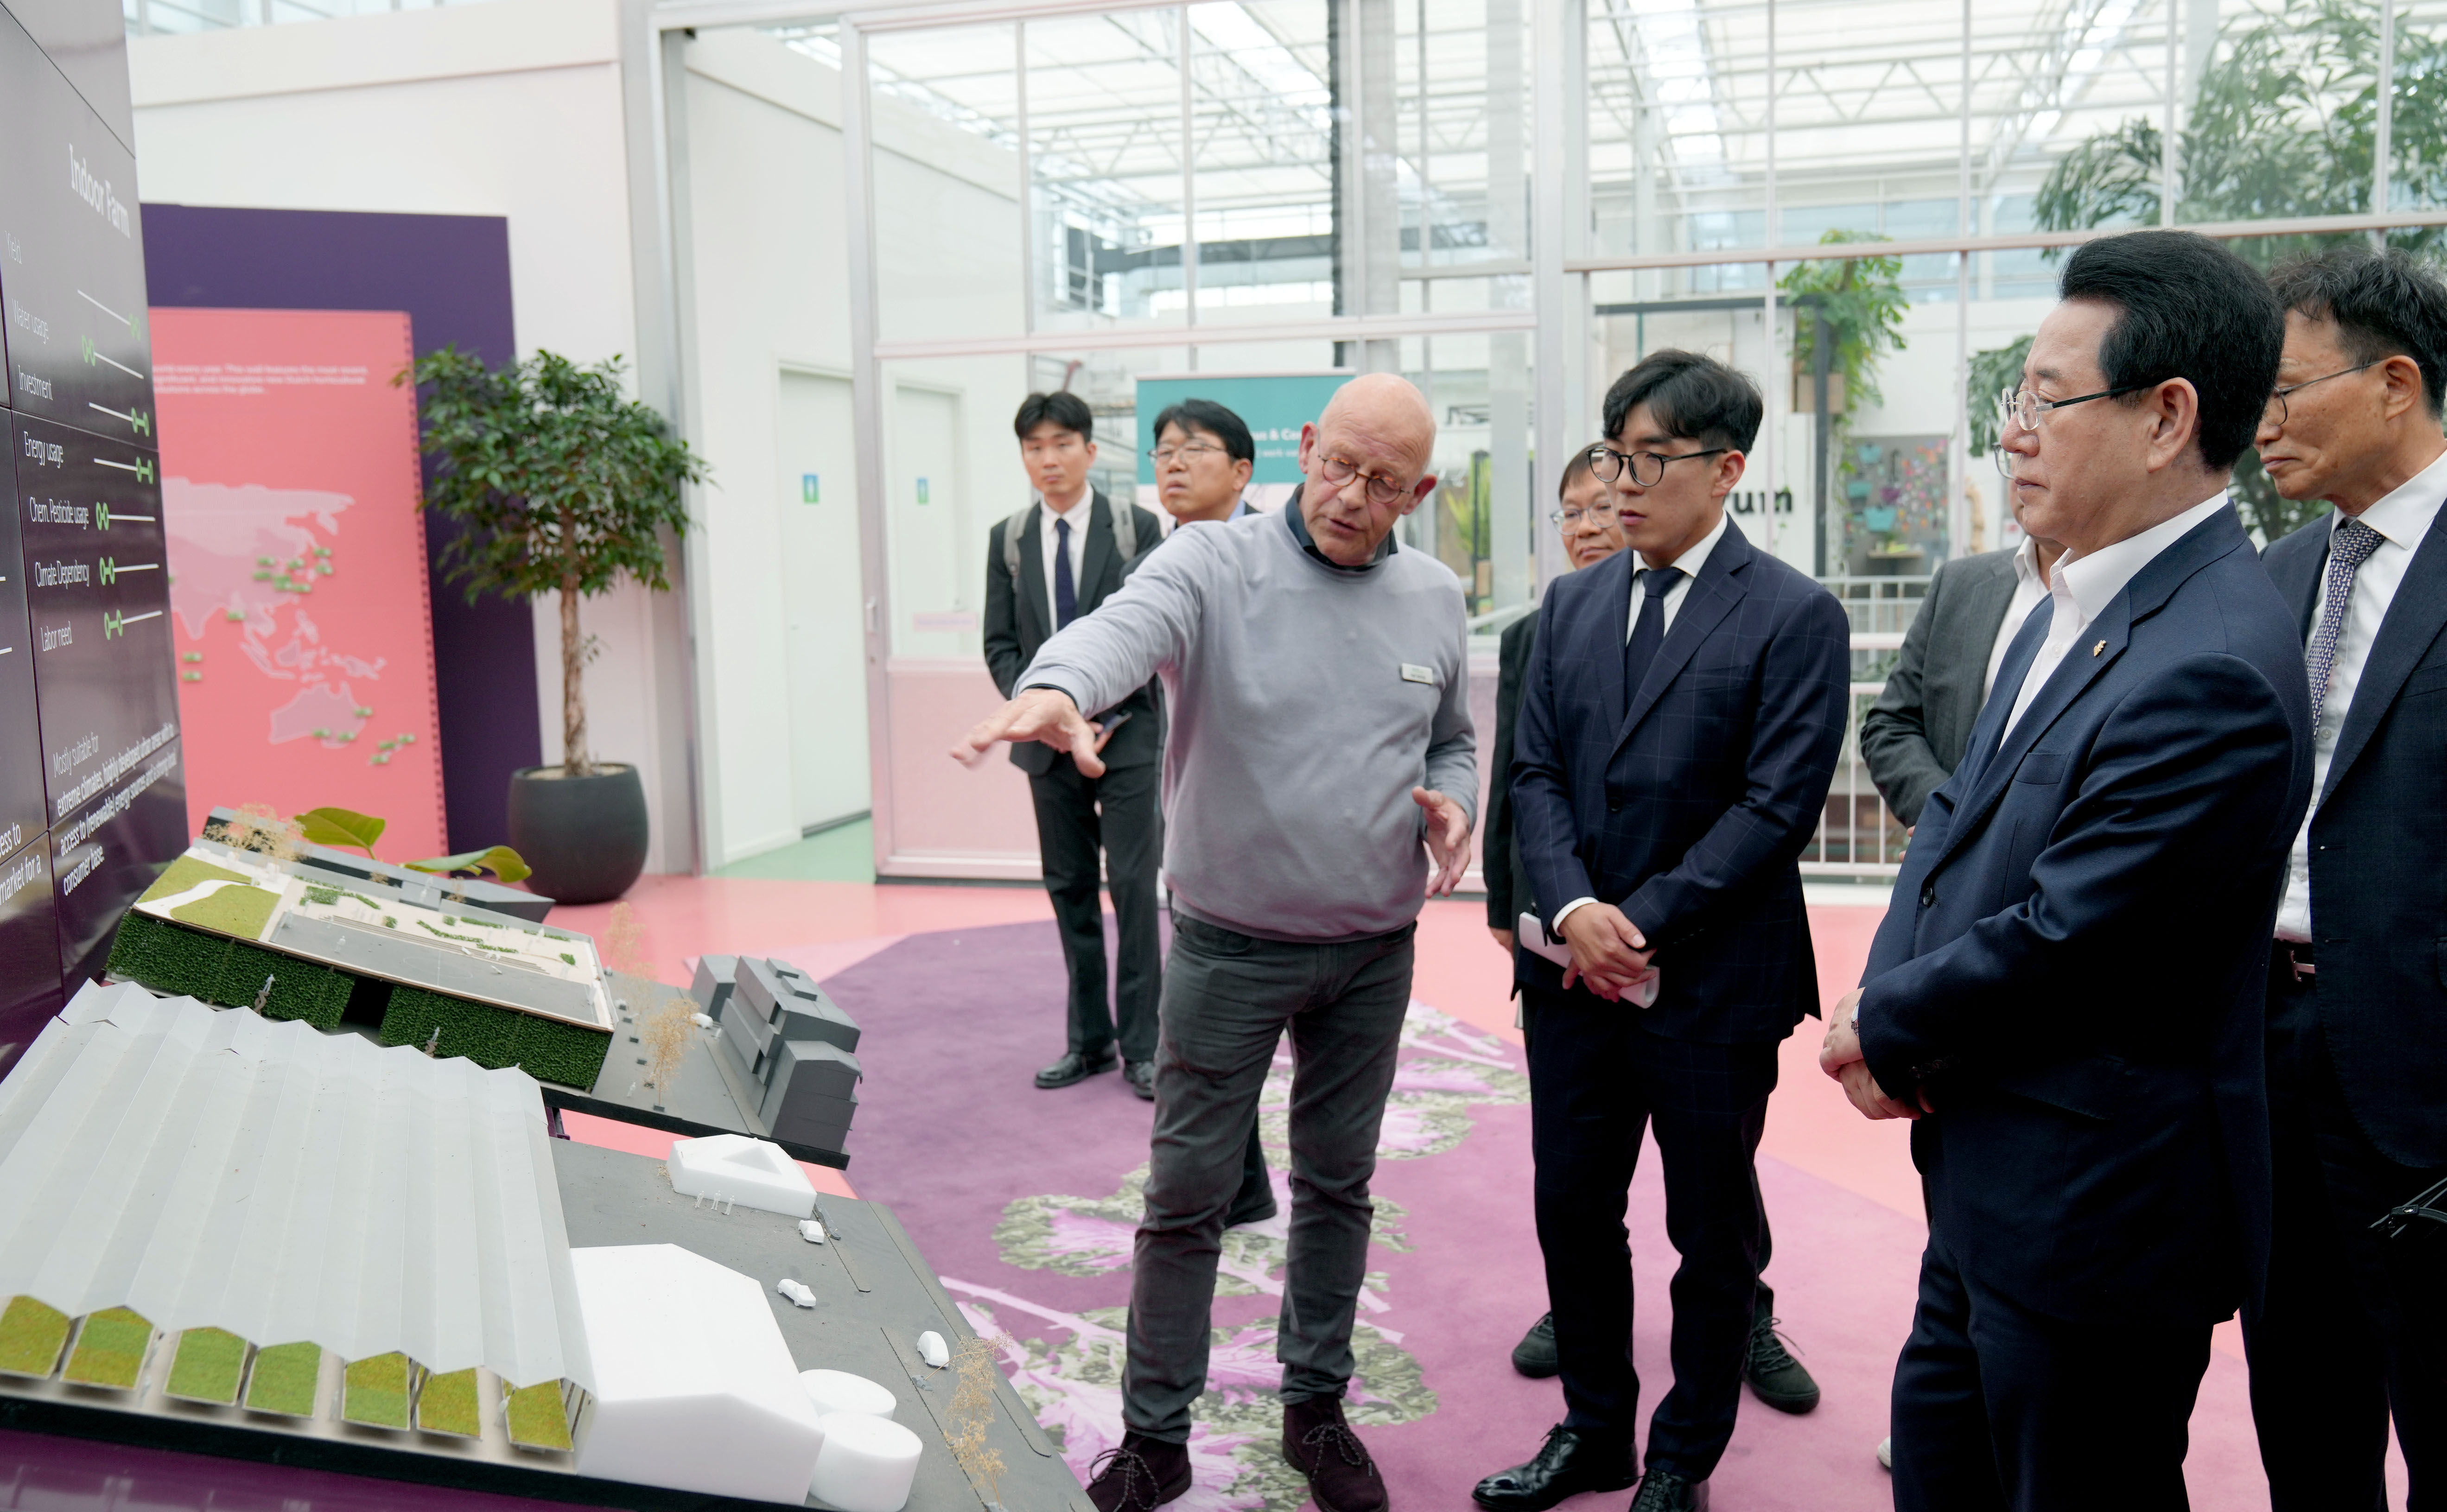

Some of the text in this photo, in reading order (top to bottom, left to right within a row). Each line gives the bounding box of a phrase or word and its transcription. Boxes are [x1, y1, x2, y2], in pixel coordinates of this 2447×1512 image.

[69, 143, 130, 239] Indoor Farm
[5, 230, 22, 265] Yield
[12, 298, 49, 344] Water usage
[18, 365, 53, 400] Investment
[24, 431, 64, 469] Energy usage
[49, 498, 74, 524] Pesticide
[73, 507, 89, 530] usage
[35, 559, 90, 590] Climate Dependency
[40, 620, 73, 652] Labor need
[53, 731, 99, 778] Mostly suitable for
[57, 786, 82, 818] extreme
[81, 770, 105, 800] climates,
[102, 756, 120, 787] highly
[118, 740, 141, 774] developed
[0, 822, 21, 857] ess to
[60, 826, 80, 857] access
[79, 820, 87, 841] to
[86, 792, 116, 838] (renewable)
[115, 786, 131, 812] energy
[25, 856, 35, 884] for
[36, 854, 42, 875] a
[63, 845, 105, 896] consumer base.
